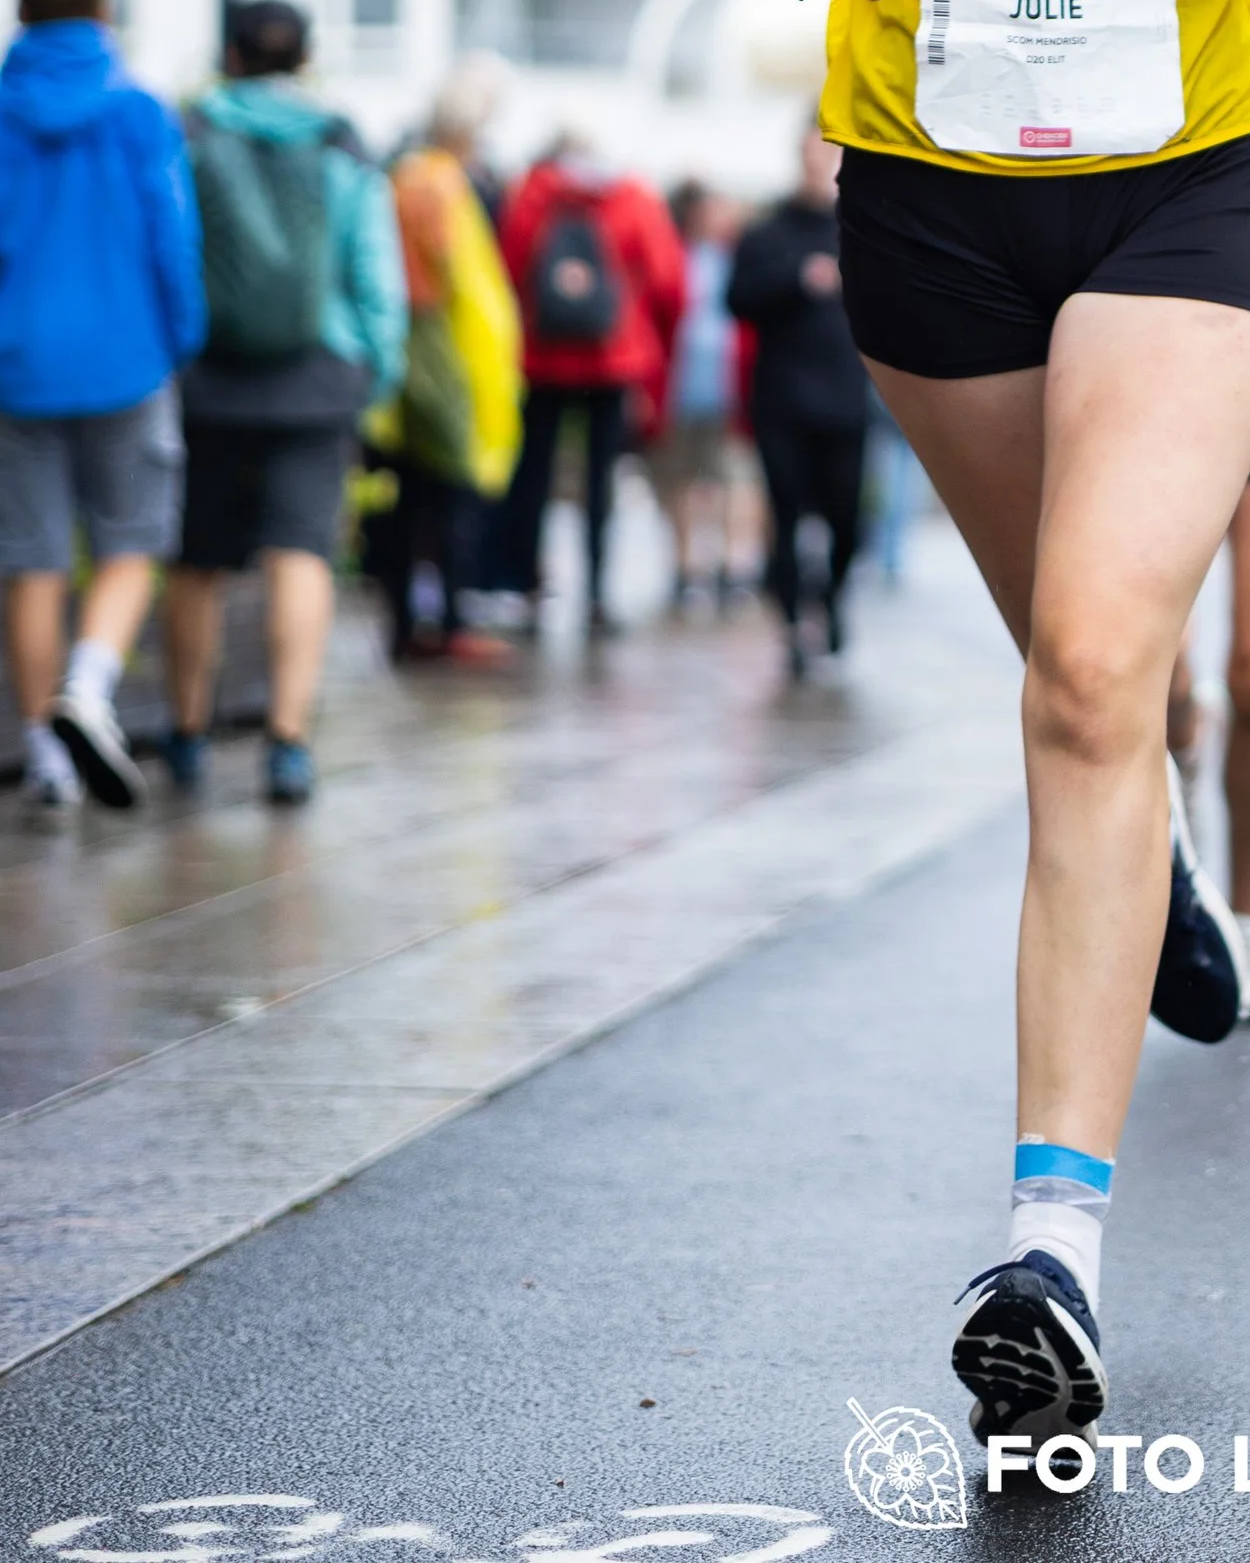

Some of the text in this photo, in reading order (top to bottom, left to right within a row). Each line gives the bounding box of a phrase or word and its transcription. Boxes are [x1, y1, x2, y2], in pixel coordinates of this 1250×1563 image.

[1006, 35, 1087, 46] SCOM MENDRISIO
[1047, 55, 1066, 64] ELIT
